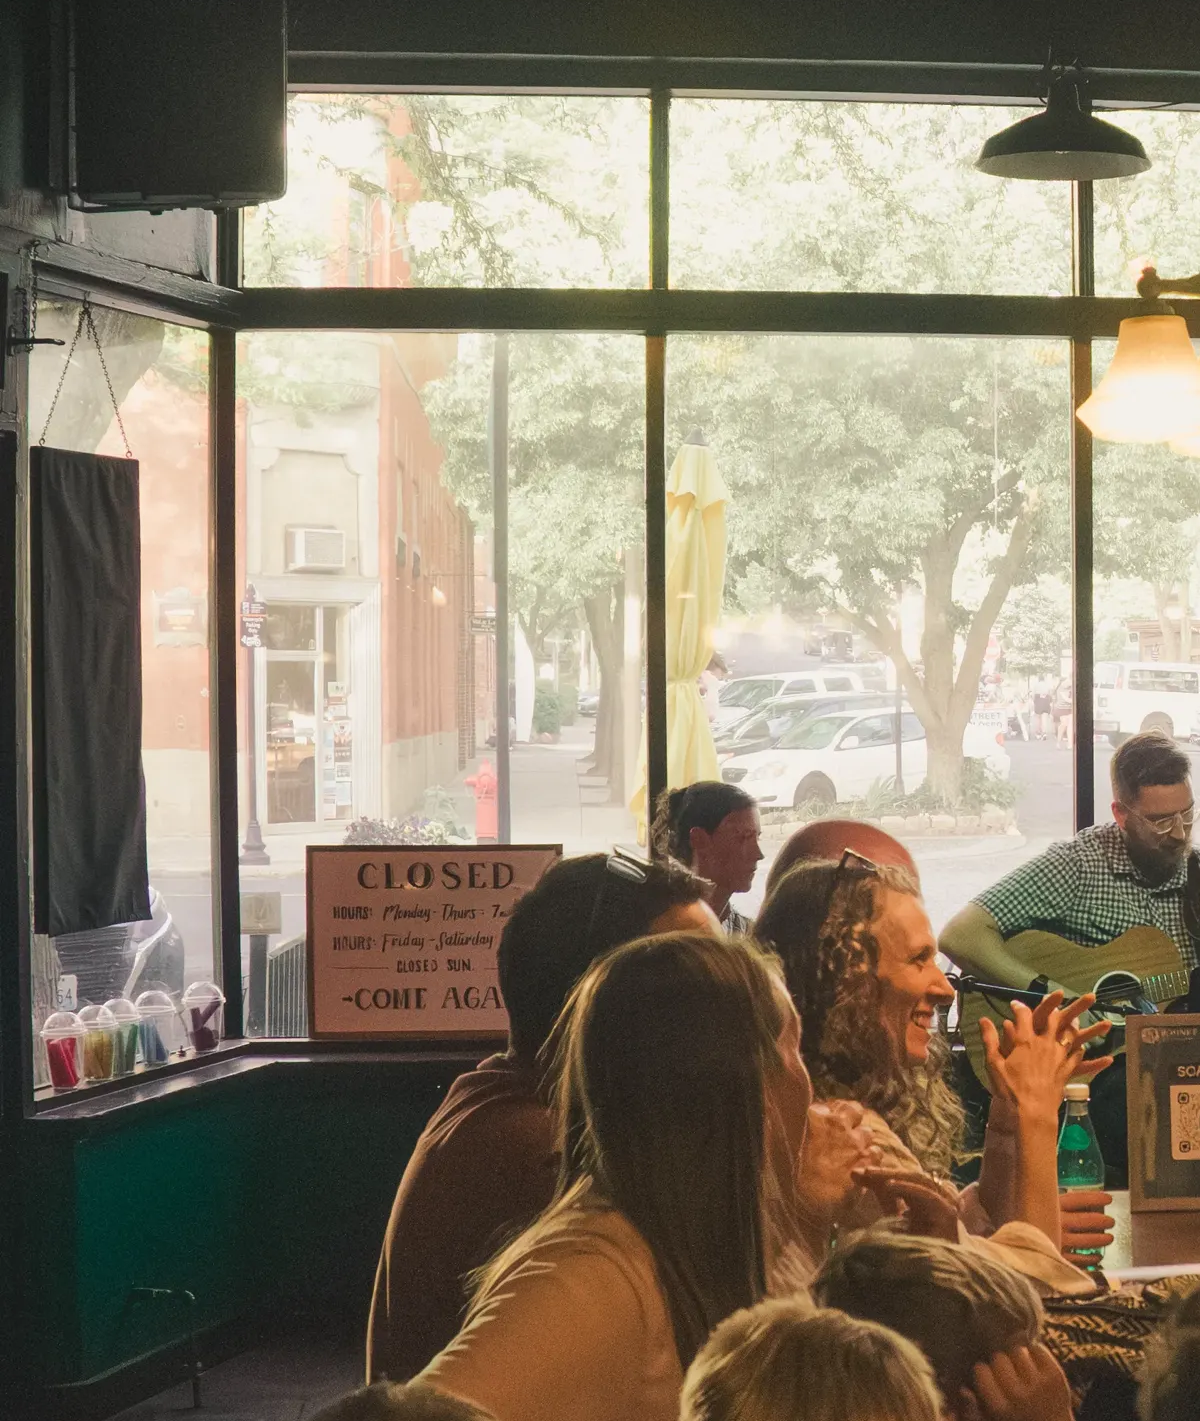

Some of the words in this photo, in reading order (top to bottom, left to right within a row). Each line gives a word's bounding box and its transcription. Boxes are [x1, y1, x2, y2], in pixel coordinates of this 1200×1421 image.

[357, 862, 515, 890] CLOSED
[333, 906, 373, 920] HOURS:
[333, 935, 376, 951] HOURS:
[397, 959, 438, 973] CLOSED
[354, 987, 428, 1011] COME
[441, 986, 507, 1010] AGA
